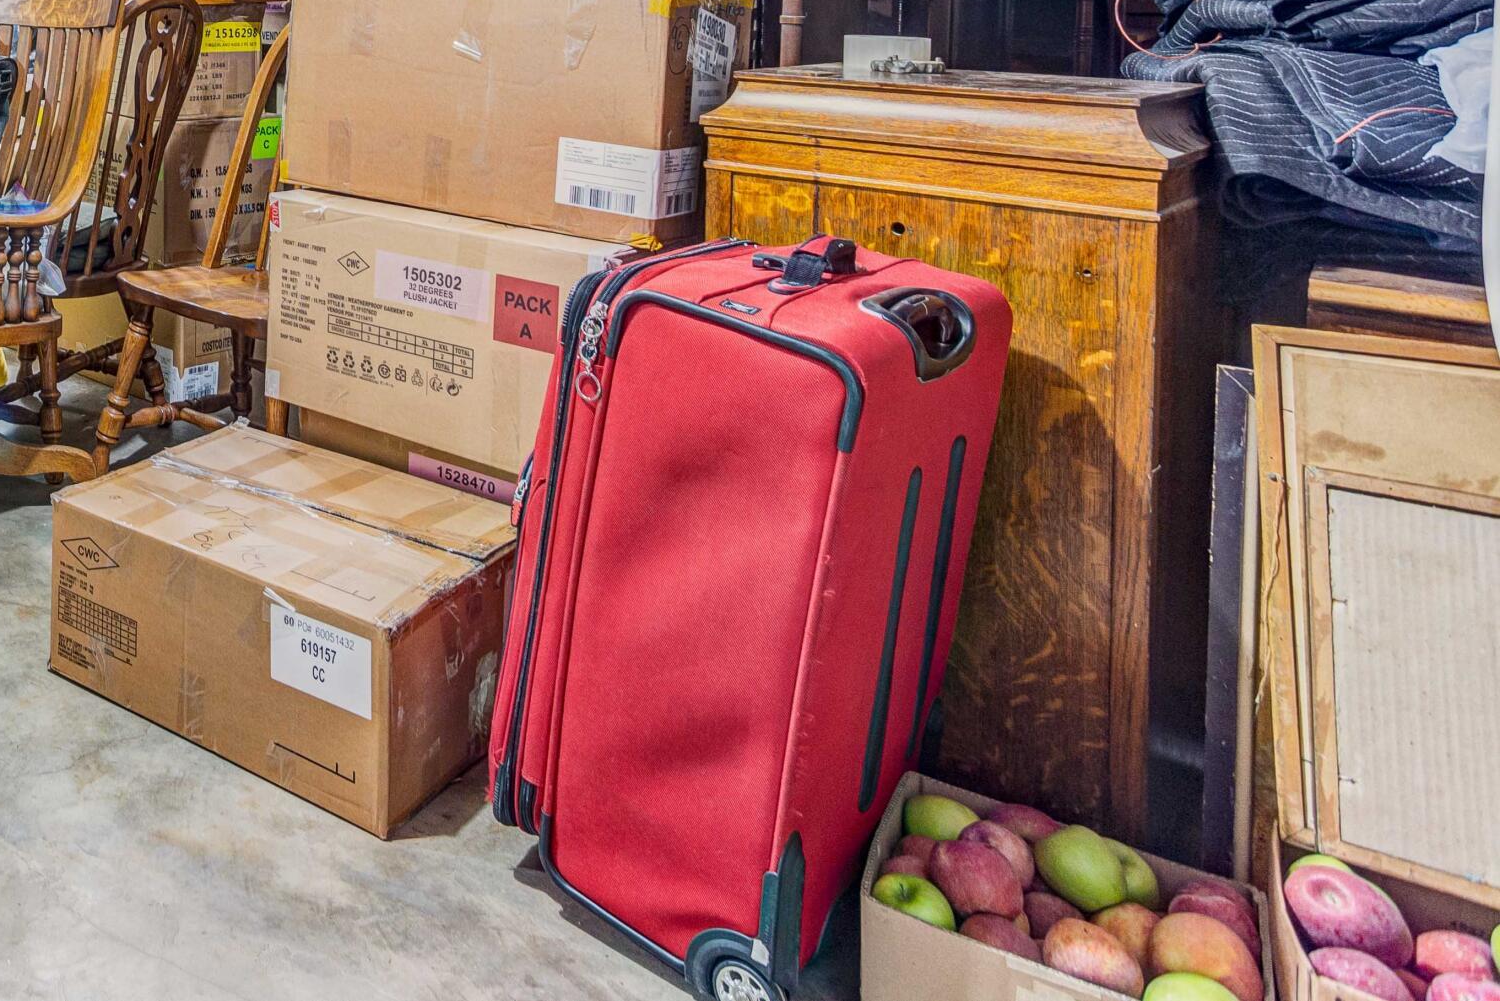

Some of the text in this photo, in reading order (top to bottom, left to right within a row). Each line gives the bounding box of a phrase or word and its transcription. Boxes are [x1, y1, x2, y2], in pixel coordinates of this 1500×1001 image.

[215, 28, 258, 39] 1516298
[262, 31, 280, 40] VEND
[264, 140, 270, 149] C
[346, 258, 361, 270] CWC
[403, 265, 462, 291] 1505302
[409, 282, 454, 299] 32 DEGREES
[328, 293, 345, 301] VENDOR
[348, 297, 383, 310] WEATHERPROOF
[384, 304, 406, 315] GARMENT
[328, 300, 339, 308] STYLE
[404, 291, 458, 311] PLUSH JACKET
[504, 291, 552, 316] PACK
[327, 306, 344, 316] VENDOR
[336, 319, 351, 327] COLOR
[439, 344, 449, 352] XXL
[455, 347, 471, 357] TOTAL
[519, 323, 533, 340] A
[202, 339, 222, 353] COSTCO
[435, 362, 450, 372] TOTAL
[437, 466, 495, 494] 1528470
[78, 545, 100, 563] CWC
[298, 620, 312, 633] PO#
[315, 626, 355, 652] 60051432
[301, 638, 337, 664] 619157
[312, 665, 325, 683] CC
